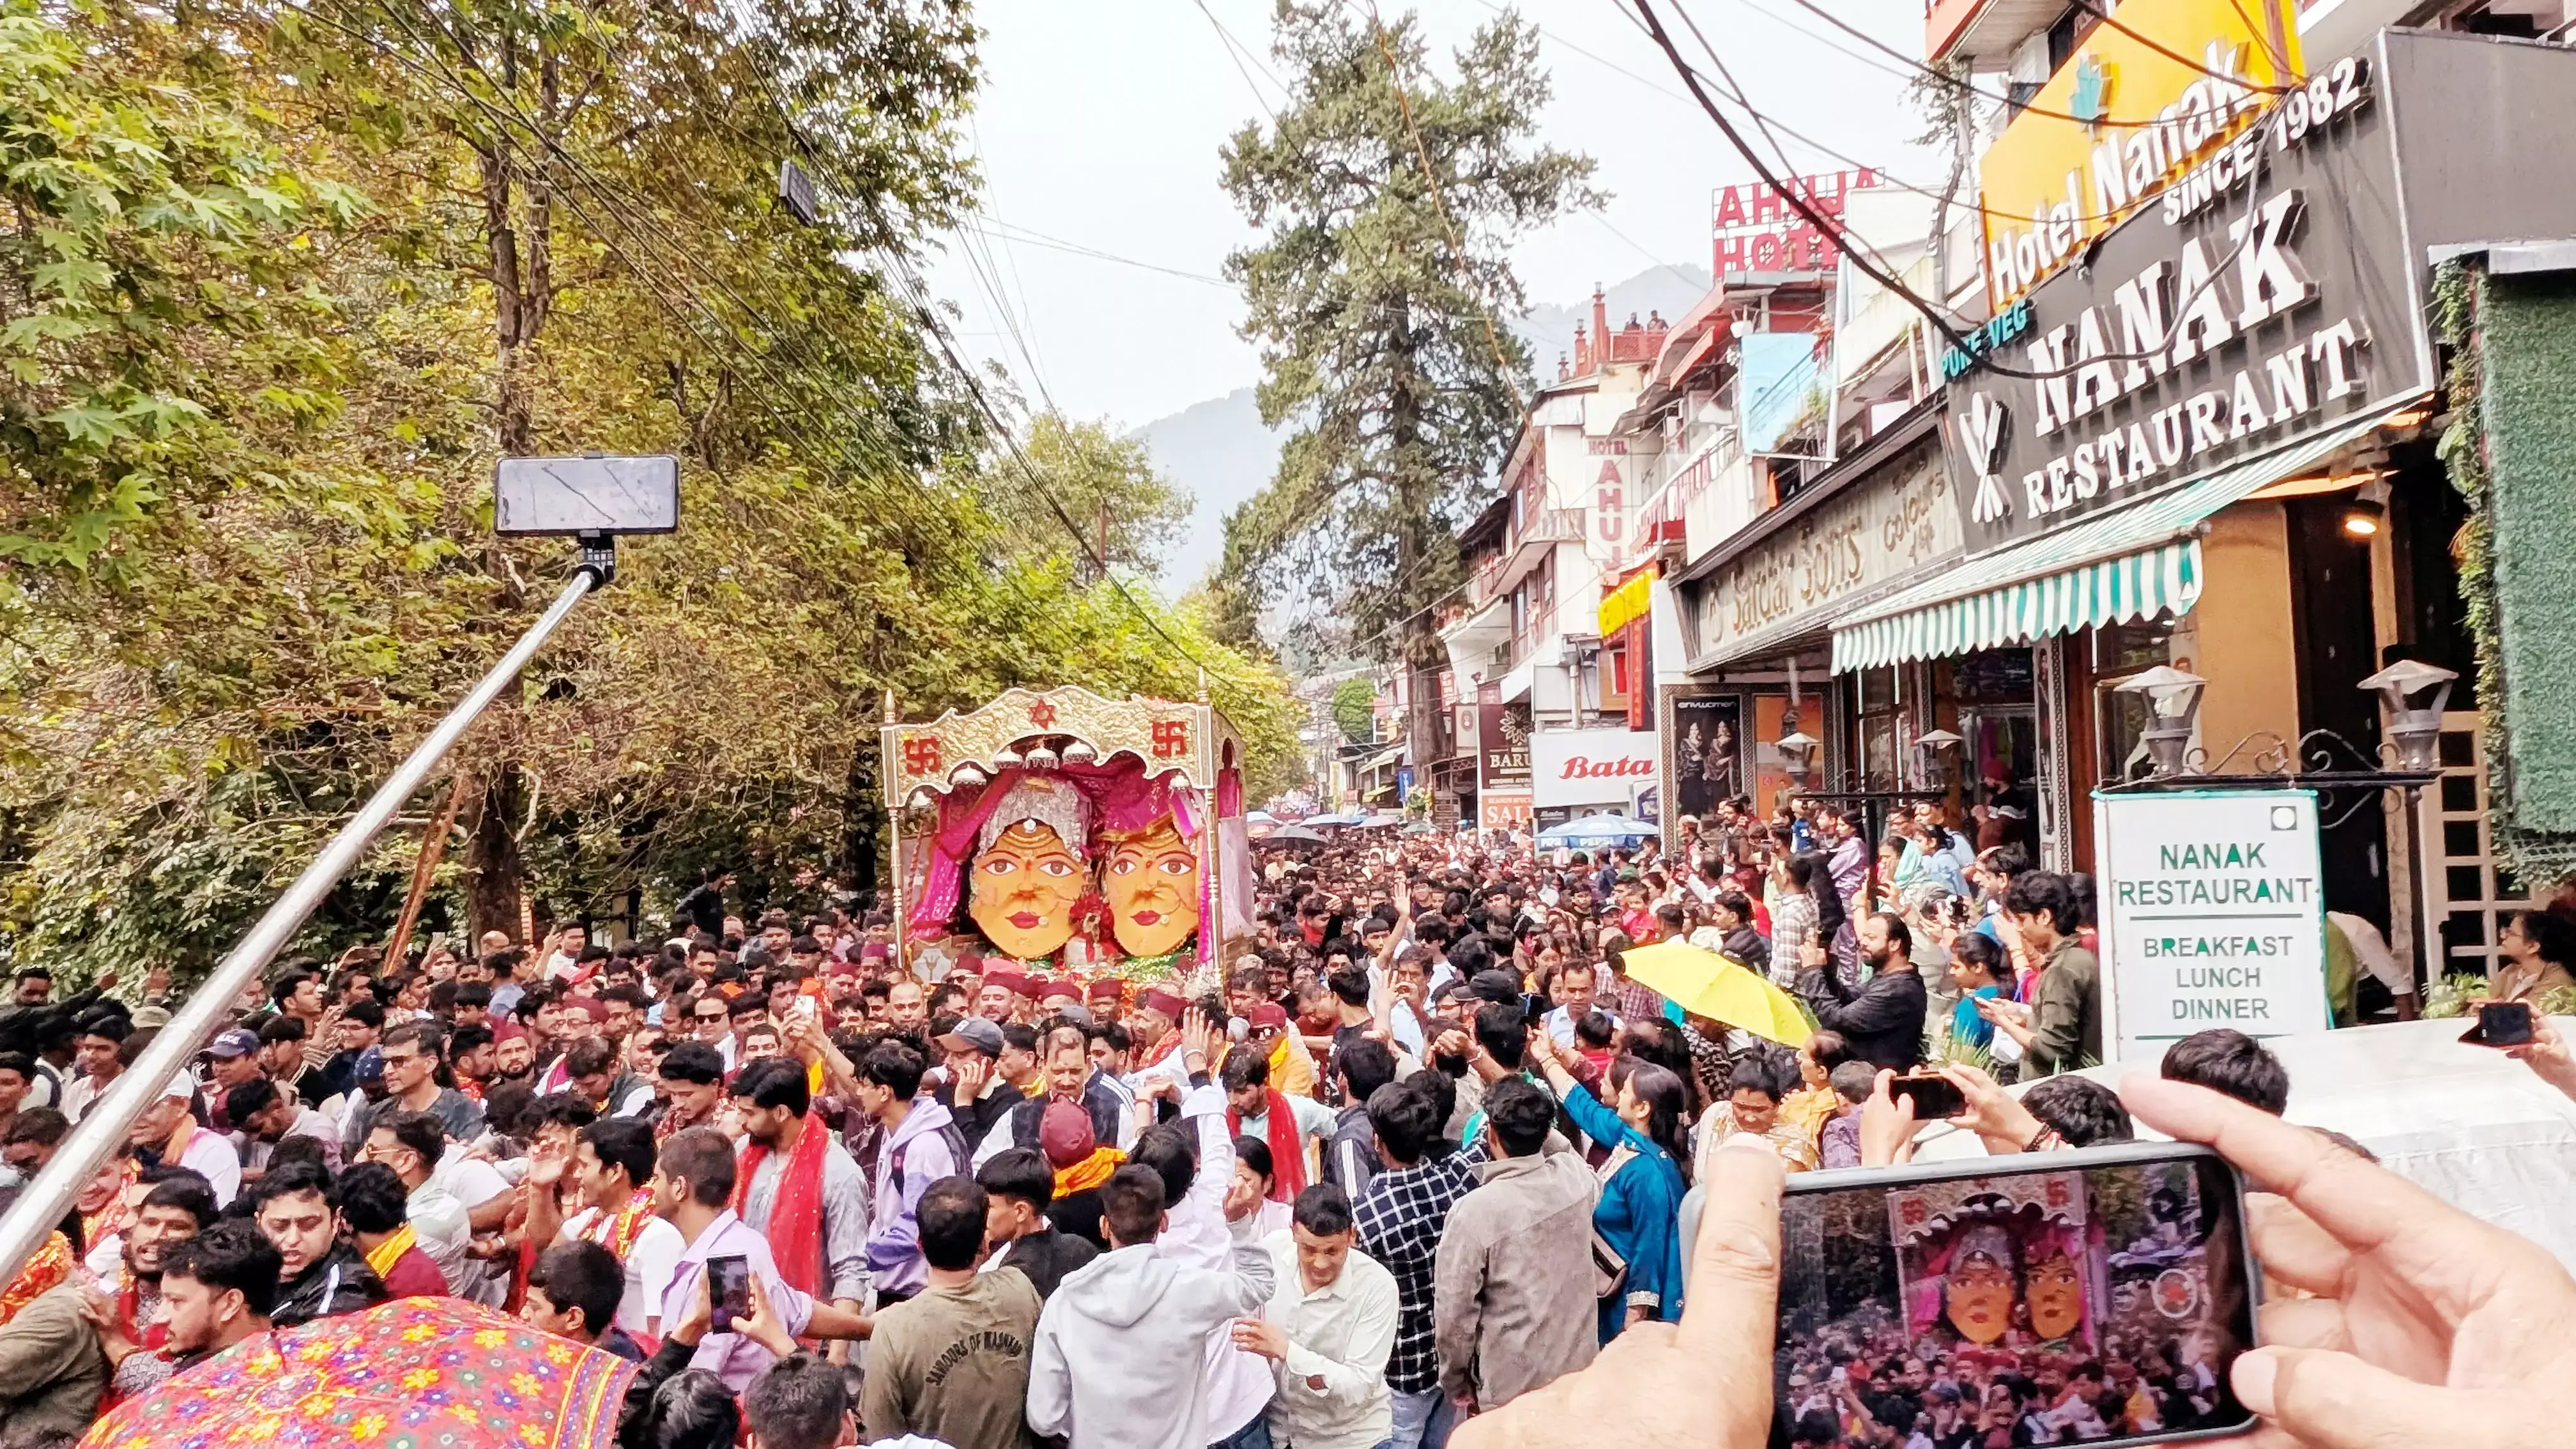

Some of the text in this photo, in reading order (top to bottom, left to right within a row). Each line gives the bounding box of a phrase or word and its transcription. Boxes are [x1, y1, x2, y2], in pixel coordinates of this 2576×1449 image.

[2163, 56, 2361, 226] SINCE 1982
[1990, 39, 2250, 305] Hotel Nanak
[1713, 219, 1846, 280] HOTE
[1988, 299, 2028, 351] VEG
[2027, 189, 2306, 437] NANAK
[2023, 318, 2356, 519] RESTAURANT
[1588, 440, 1628, 455] HOTEL
[1559, 755, 1656, 779] Bata
[2160, 842, 2267, 870] NANAK
[2119, 878, 2313, 906] RESTAURANT
[2144, 936, 2294, 958] BREAKFAST
[2176, 967, 2261, 988] LUNCH
[2172, 998, 2270, 1020] DINNER
[969, 1332, 982, 1353] OF
